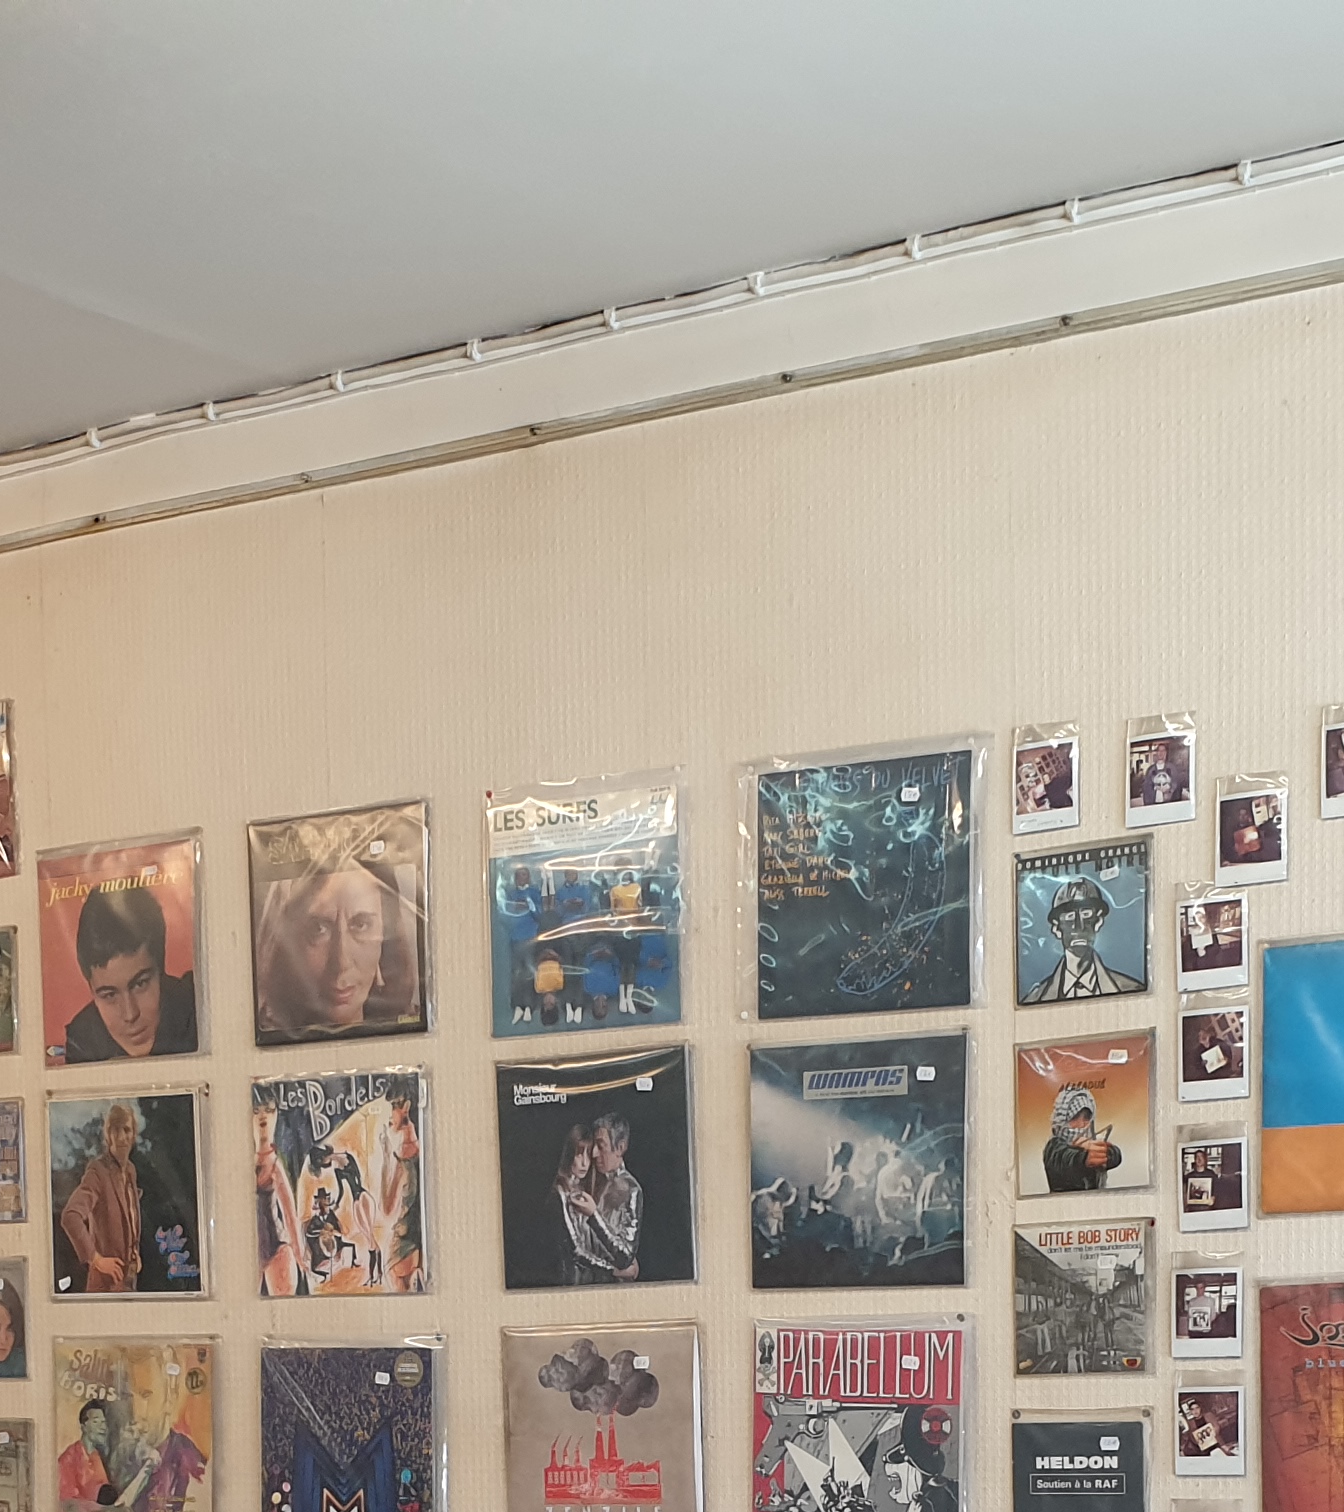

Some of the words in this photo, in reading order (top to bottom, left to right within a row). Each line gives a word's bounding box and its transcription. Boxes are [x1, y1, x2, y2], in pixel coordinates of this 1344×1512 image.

[493, 808, 526, 833] LES
[535, 799, 600, 828] SURFS
[1017, 852, 1091, 871] DOMINIQUE
[513, 1083, 557, 1097] Monsieur
[514, 1092, 568, 1106] Gainsbourg
[306, 1073, 388, 1142] Bordels
[1038, 1231, 1074, 1247] LITTLE
[1077, 1229, 1102, 1245] BOB
[1104, 1227, 1142, 1244] STORY
[1035, 1456, 1118, 1470] HELDON
[1036, 1479, 1073, 1489] Soutien
[1083, 1478, 1093, 1489] la
[1094, 1479, 1119, 1489] RAF
